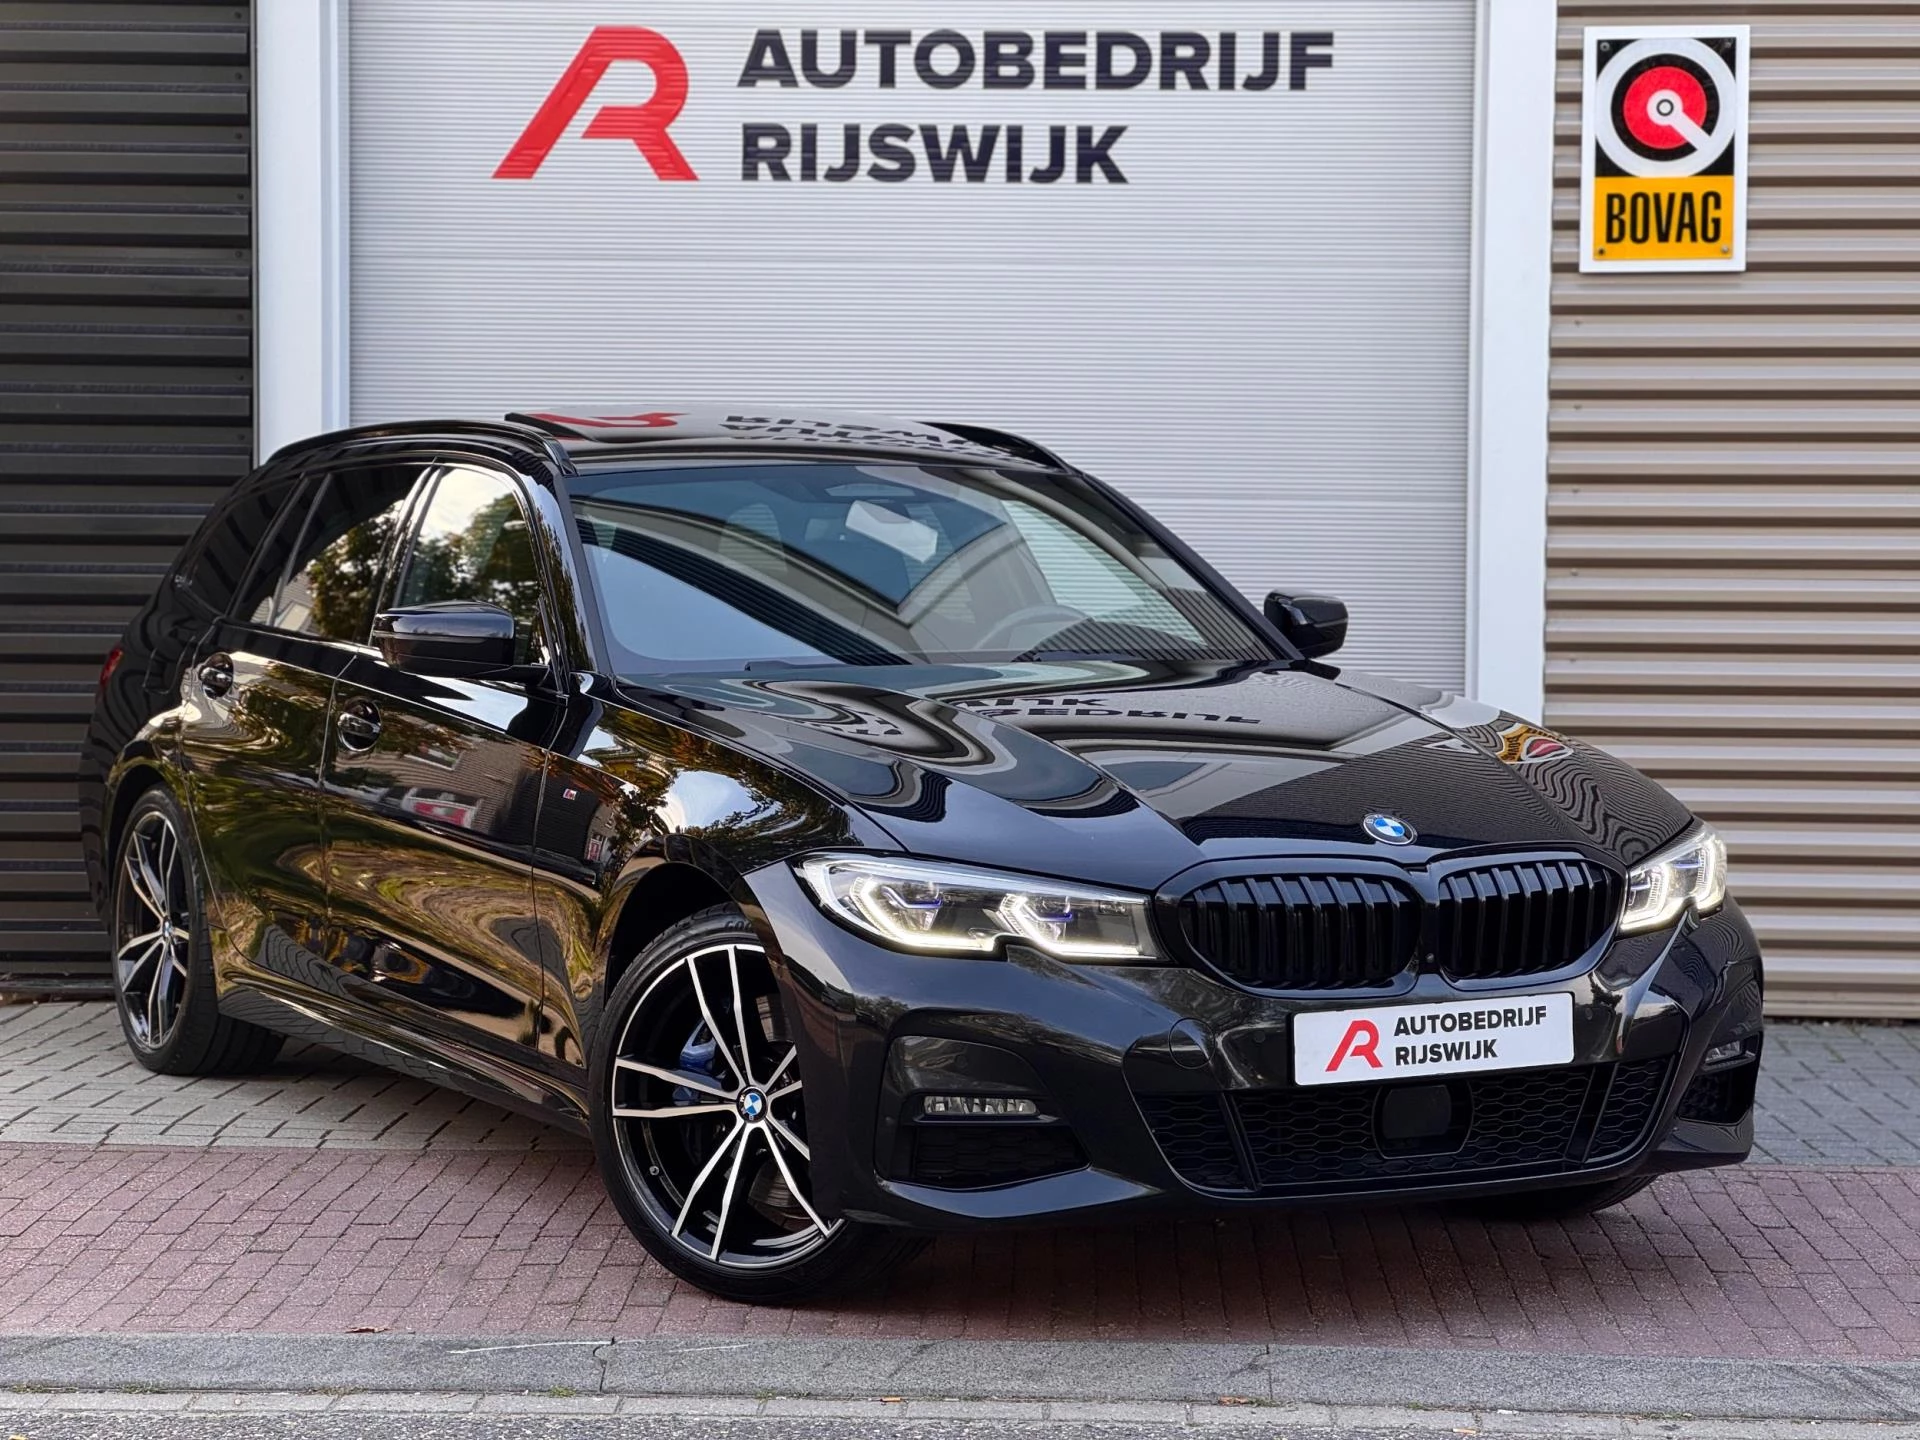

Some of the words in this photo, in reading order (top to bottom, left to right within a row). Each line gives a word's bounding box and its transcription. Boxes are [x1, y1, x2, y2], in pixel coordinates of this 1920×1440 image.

[737, 29, 1335, 91] AUTOBEDRIJF
[741, 123, 1128, 184] RIJSWIJK
[1605, 190, 1722, 245] BOVAG
[1393, 1005, 1547, 1037] AUTOBEDRIJF
[1395, 1039, 1498, 1066] RIJSWIJK
